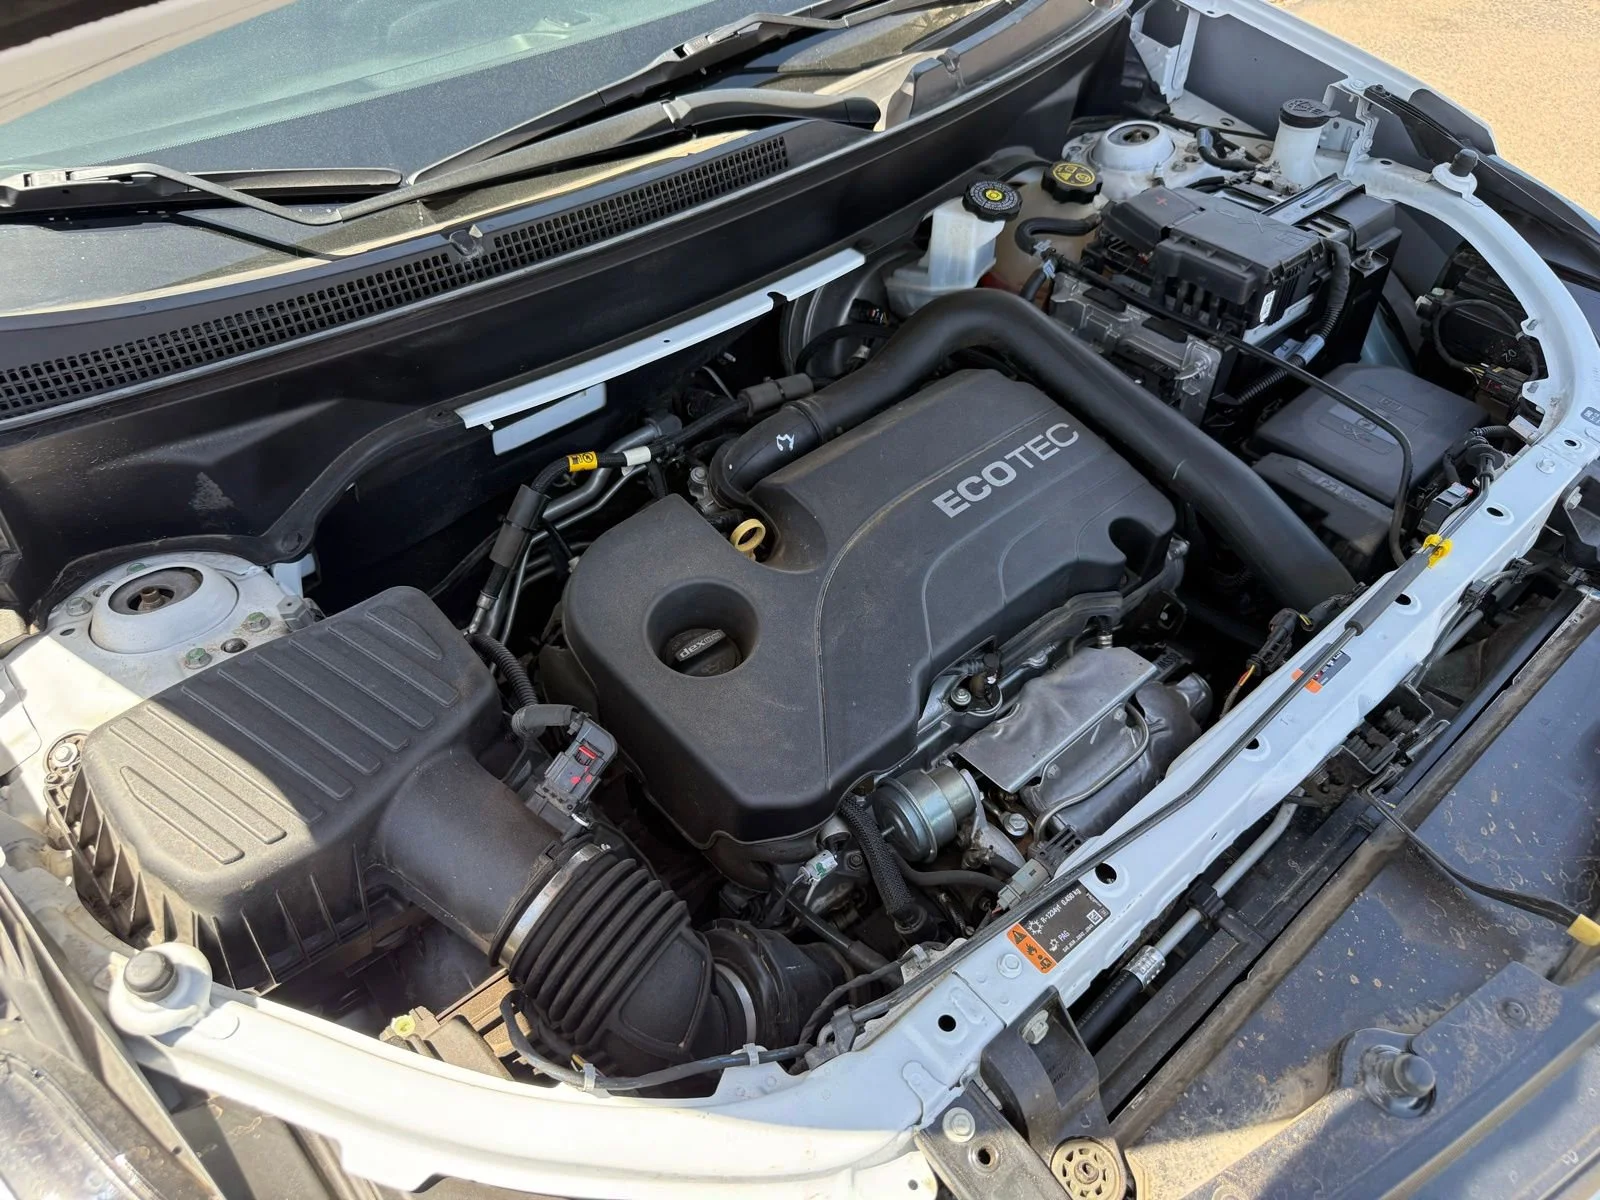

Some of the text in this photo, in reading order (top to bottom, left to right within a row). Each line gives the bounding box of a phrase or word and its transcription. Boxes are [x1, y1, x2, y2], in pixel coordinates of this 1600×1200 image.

[932, 422, 1079, 518] ECOTEC
[1072, 888, 1082, 896] kg
[1058, 930, 1070, 942] PAG
